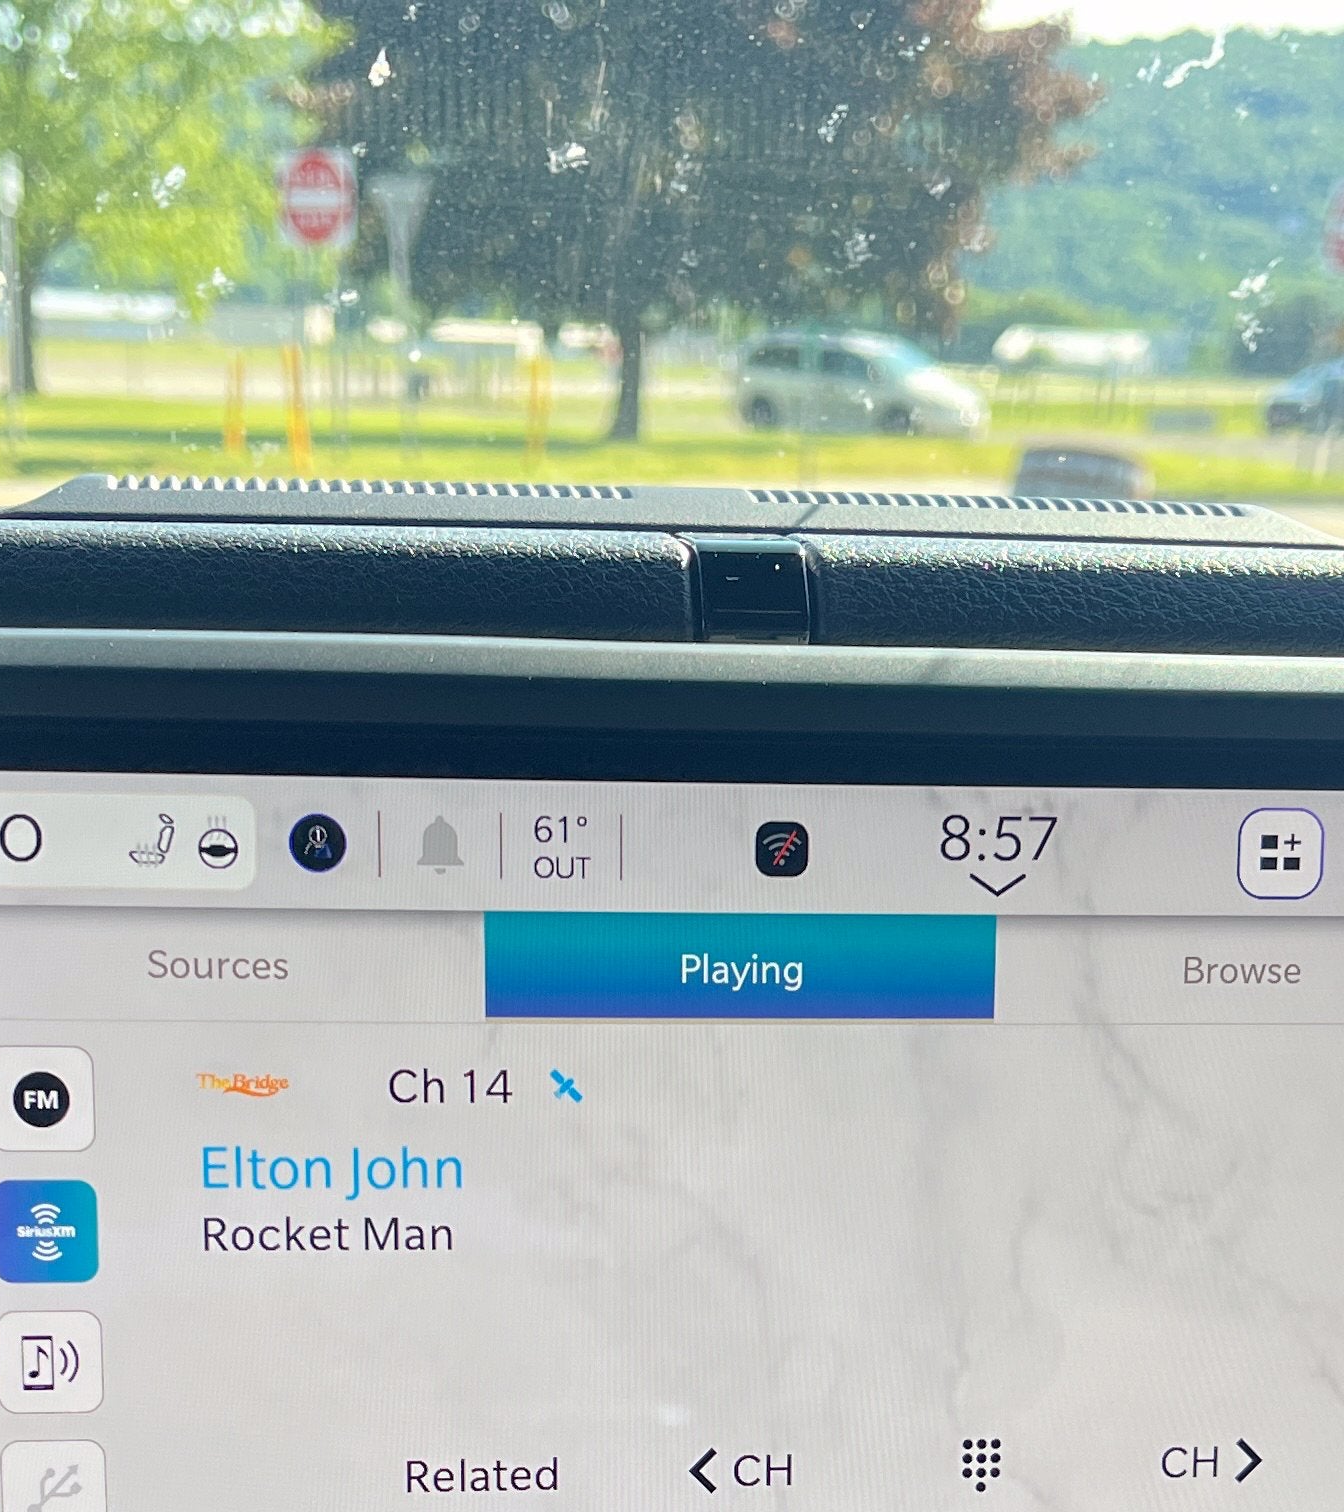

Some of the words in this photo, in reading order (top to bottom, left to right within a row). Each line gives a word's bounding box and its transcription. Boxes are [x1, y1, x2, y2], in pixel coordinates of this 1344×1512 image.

[940, 813, 1058, 862] 8:57
[533, 856, 592, 880] OUT
[147, 949, 289, 980] Sources
[681, 953, 804, 992] Playing
[1183, 956, 1302, 985] Browse
[23, 1090, 59, 1111] FM
[388, 1069, 446, 1104] Ch
[463, 1069, 513, 1104] 14
[202, 1146, 332, 1189] Elton
[345, 1145, 463, 1201] John
[202, 1217, 350, 1252] Rocket
[363, 1217, 454, 1251] Man
[405, 1457, 559, 1493] Related
[733, 1453, 793, 1487] CH
[1160, 1446, 1219, 1478] CH
